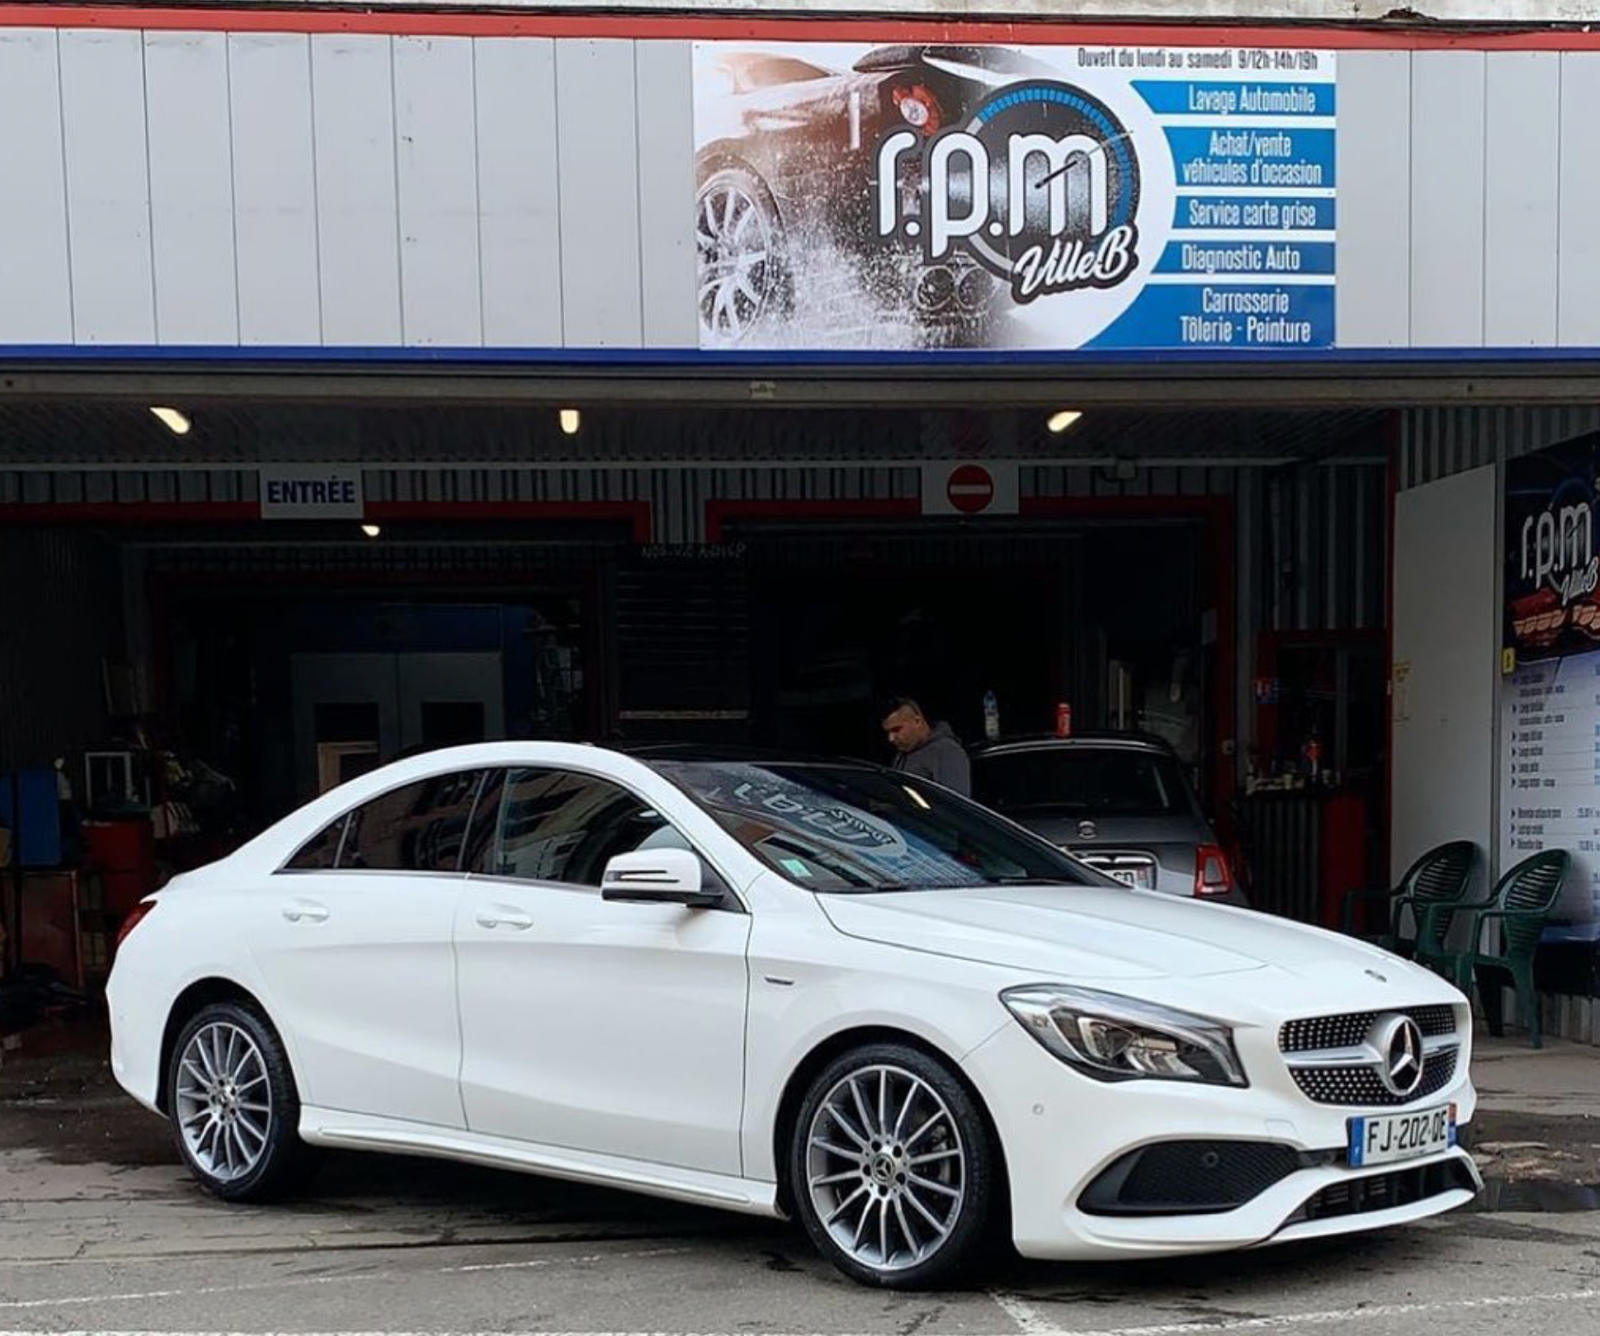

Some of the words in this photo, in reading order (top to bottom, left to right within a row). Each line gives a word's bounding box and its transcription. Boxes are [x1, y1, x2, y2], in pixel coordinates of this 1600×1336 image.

[1078, 48, 1116, 67] Ouvert
[1119, 49, 1134, 67] du
[1137, 49, 1166, 67] lundi
[1169, 51, 1184, 67] au
[1187, 50, 1232, 68] samedi
[1188, 85, 1236, 114] Lavage
[1239, 86, 1317, 112] Automobile
[1209, 131, 1292, 157] Achat/vente
[1183, 159, 1247, 183] véhicules
[1251, 160, 1322, 184] d'occasion
[879, 132, 1108, 258] r.p.m
[1189, 199, 1239, 226] Service
[1243, 202, 1279, 226] carte
[1282, 202, 1316, 229] grise
[1012, 225, 1133, 294] VilleB
[1181, 244, 1262, 273] Diagnostic
[1265, 246, 1301, 270] Auto
[1202, 288, 1290, 314] Carrosserie
[1180, 316, 1233, 342] Tôlerie
[1246, 317, 1311, 342] Peinture
[267, 474, 356, 503] ENTRÉE
